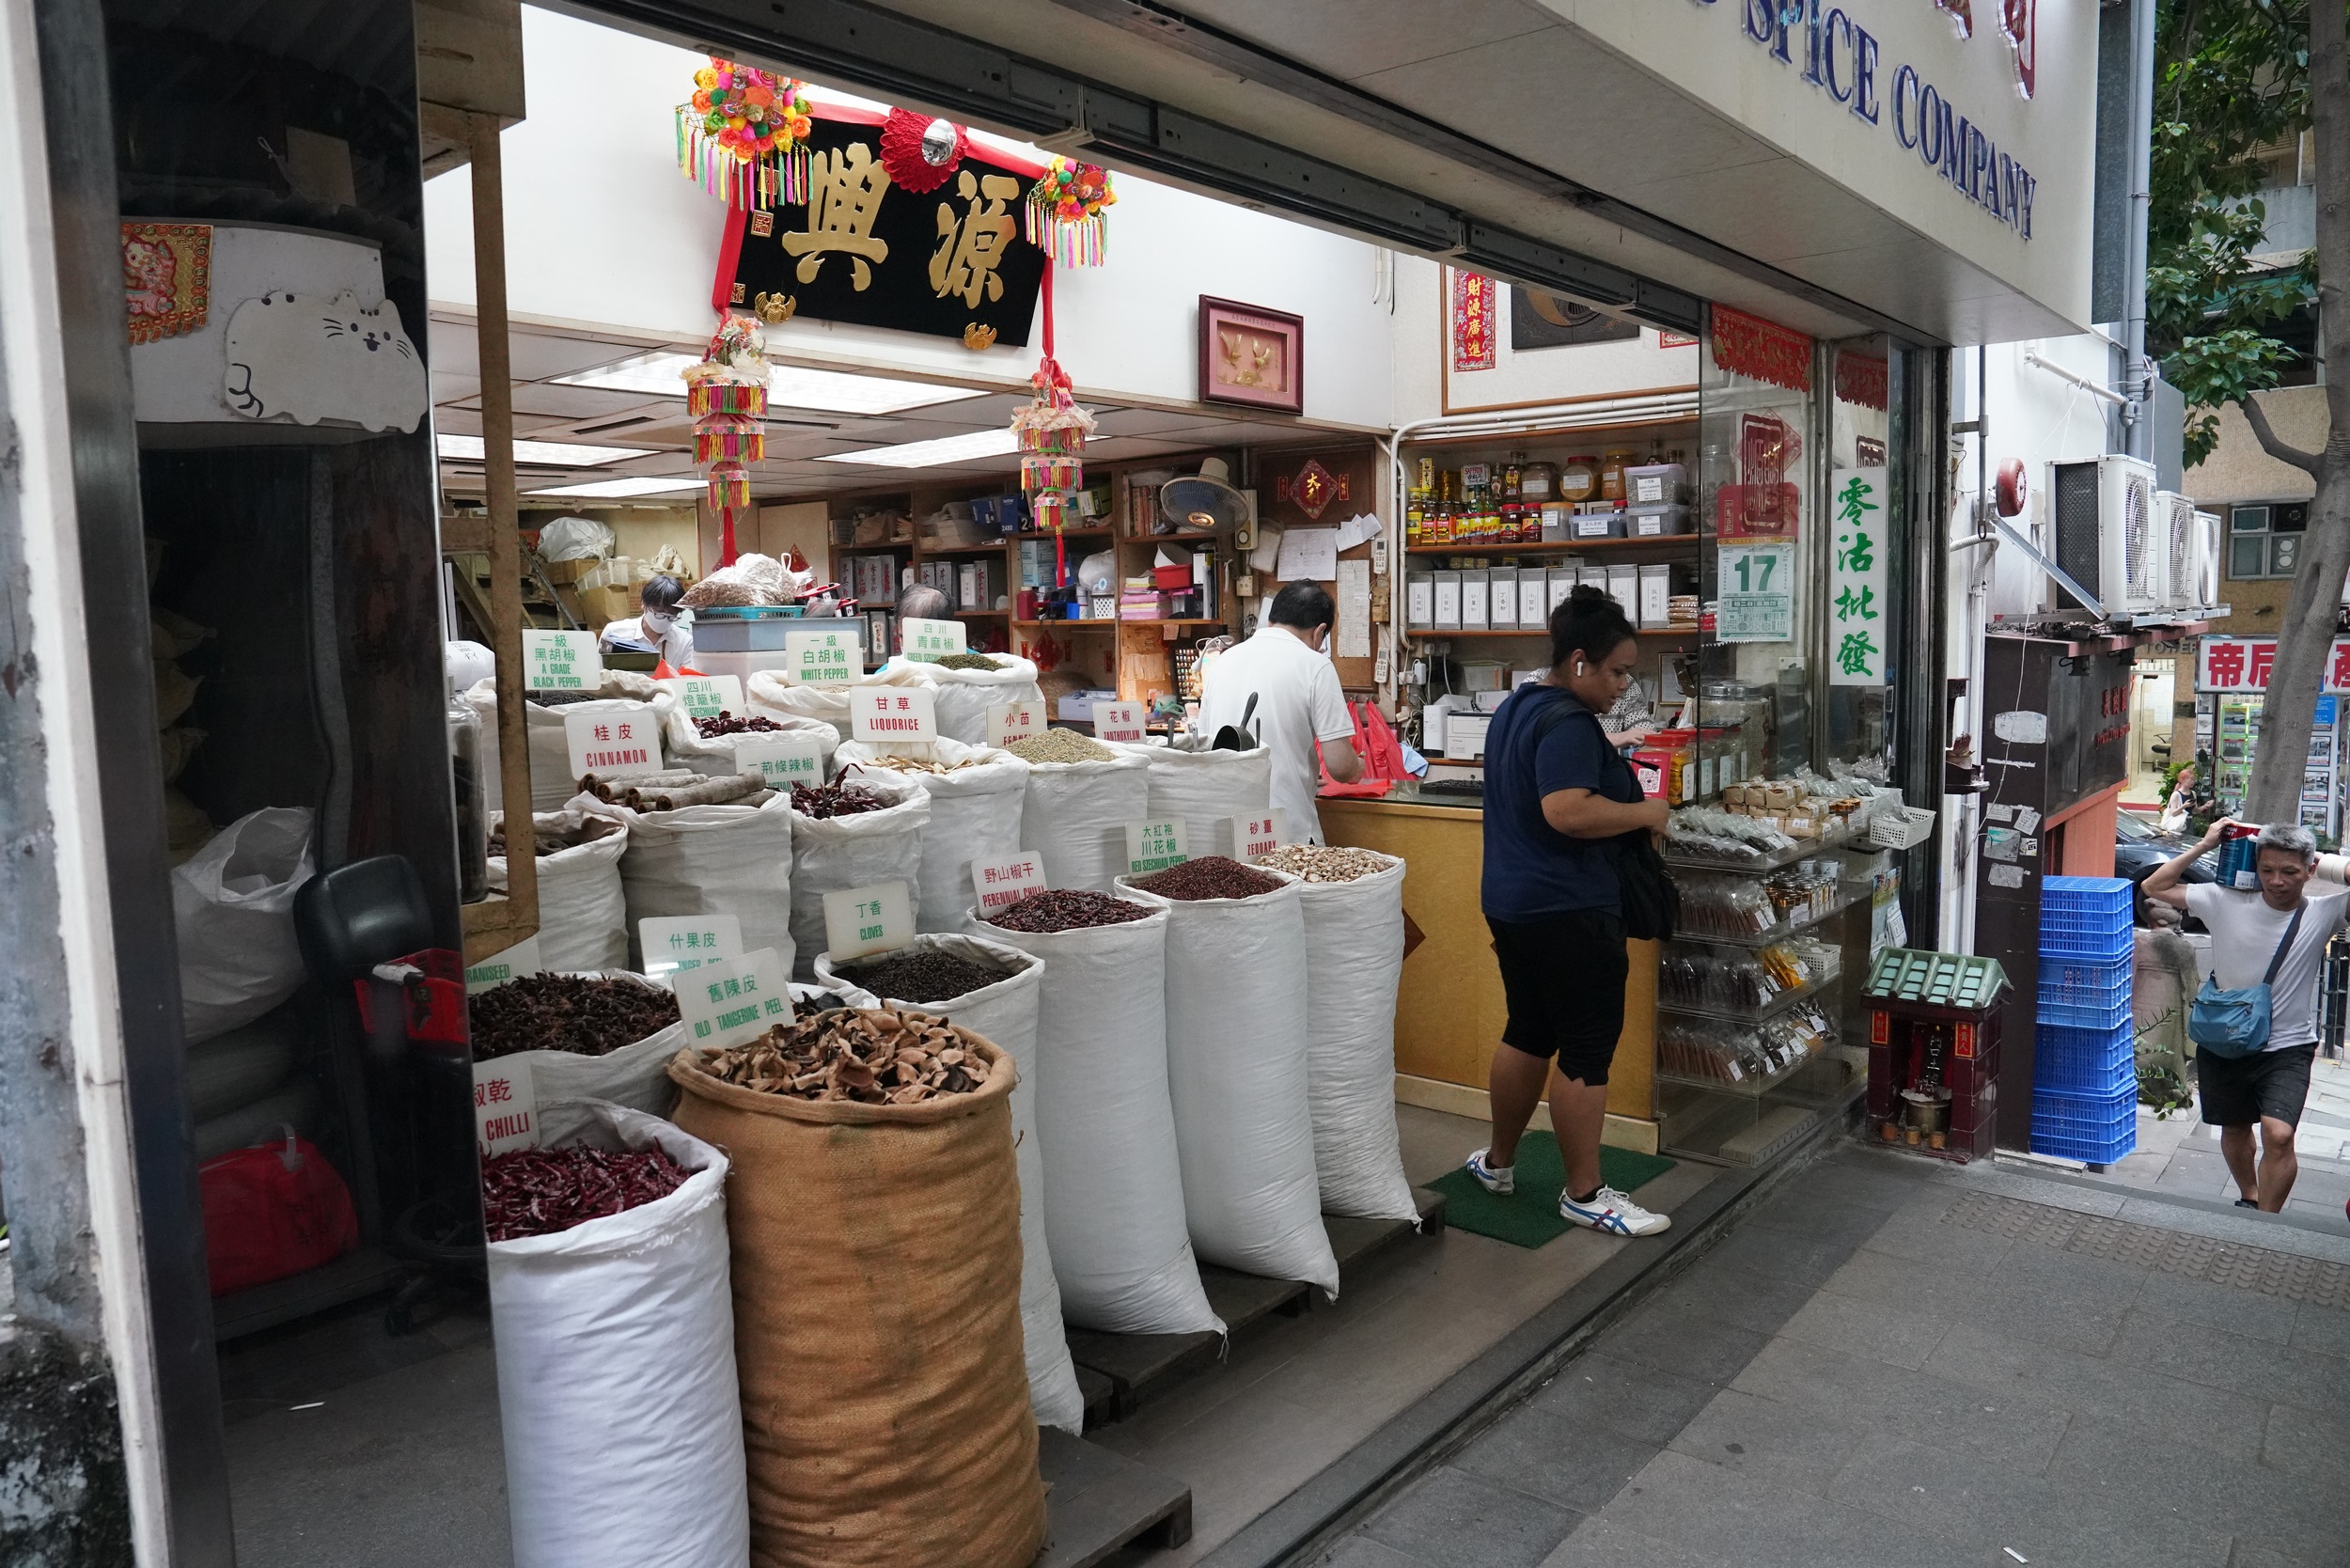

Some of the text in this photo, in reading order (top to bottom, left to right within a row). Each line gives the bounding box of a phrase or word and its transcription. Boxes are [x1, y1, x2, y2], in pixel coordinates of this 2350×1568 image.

[1891, 64, 2037, 242] COMPANY
[1466, 276, 1483, 358] 財源廣進
[1734, 555, 1777, 592] 17
[1834, 477, 1879, 677] 零沽批發
[924, 623, 947, 635] 四川
[540, 635, 567, 648] 一級
[810, 635, 837, 647] 一級
[917, 635, 954, 650] 青麻椒
[535, 648, 576, 662] 黑胡椒
[803, 649, 845, 664] 白胡椒
[541, 664, 571, 675] A GRADE
[800, 667, 849, 681] WHITE PEPPER
[533, 677, 582, 687] BLACK PEPPER
[686, 681, 713, 693] 四川
[689, 706, 720, 718] SZECHUAN
[875, 697, 911, 711] 甘草
[870, 717, 919, 731] LIQUORICE
[1005, 712, 1029, 728] 小茴
[1109, 710, 1131, 723] 花椒
[594, 723, 633, 741] 桂皮
[587, 749, 648, 767] CINNAMON
[1143, 823, 1173, 839] 大紅袍
[1141, 839, 1177, 856] 川花椒
[1247, 839, 1277, 855] ZEDOARY
[1131, 859, 1141, 873] RED
[1143, 856, 1168, 872] SZECHUAN
[984, 862, 1034, 884] 野山椒干
[982, 889, 1022, 908] PERENNIAL
[855, 900, 882, 918] 丁香
[669, 932, 716, 949] 什果皮
[859, 924, 884, 941] CLOVES
[465, 964, 510, 983] RANISEED
[706, 973, 759, 1003] 舊陳皮
[694, 997, 784, 1039] OLD TANGERINE PEEL
[485, 1112, 530, 1141] CHILLI
